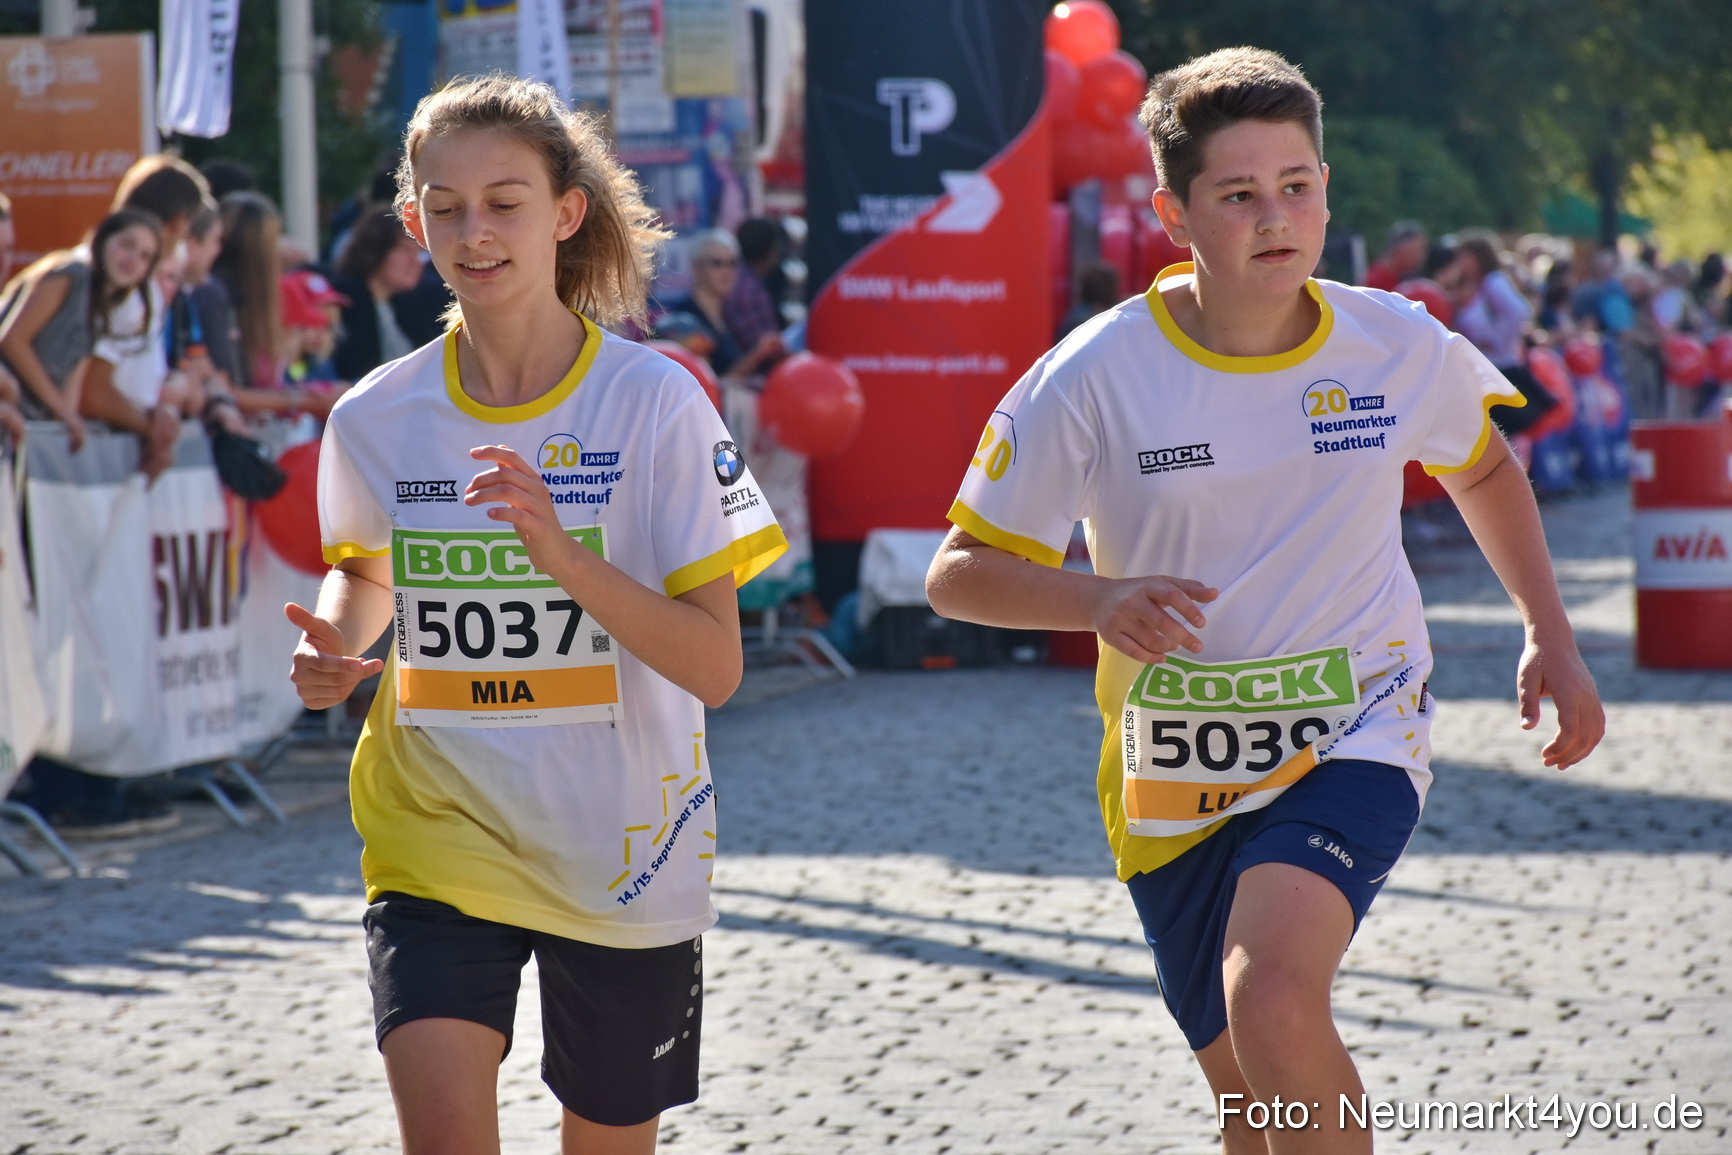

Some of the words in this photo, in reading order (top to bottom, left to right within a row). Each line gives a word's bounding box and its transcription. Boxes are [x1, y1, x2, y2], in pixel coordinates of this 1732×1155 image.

[1307, 388, 1347, 416] 20
[1354, 397, 1382, 410] JAHRE
[1310, 415, 1397, 435] Neumarkter
[543, 443, 579, 468] 20
[584, 454, 617, 465] JAHRE
[1313, 433, 1385, 454] Stadtlauf
[1138, 443, 1213, 469] BOCK
[396, 480, 458, 498] BOCK
[549, 488, 613, 505] tadtlauf
[720, 487, 757, 509] PARTL
[723, 498, 760, 518] Neumarkt
[417, 600, 584, 660] 5037
[471, 680, 535, 704] MIA
[1143, 657, 1336, 706] BOCK
[617, 872, 654, 906] 14./15.
[651, 807, 692, 872] September
[688, 783, 713, 811] 2019
[1324, 842, 1354, 868] JAKO
[652, 1037, 676, 1060] JAKO
